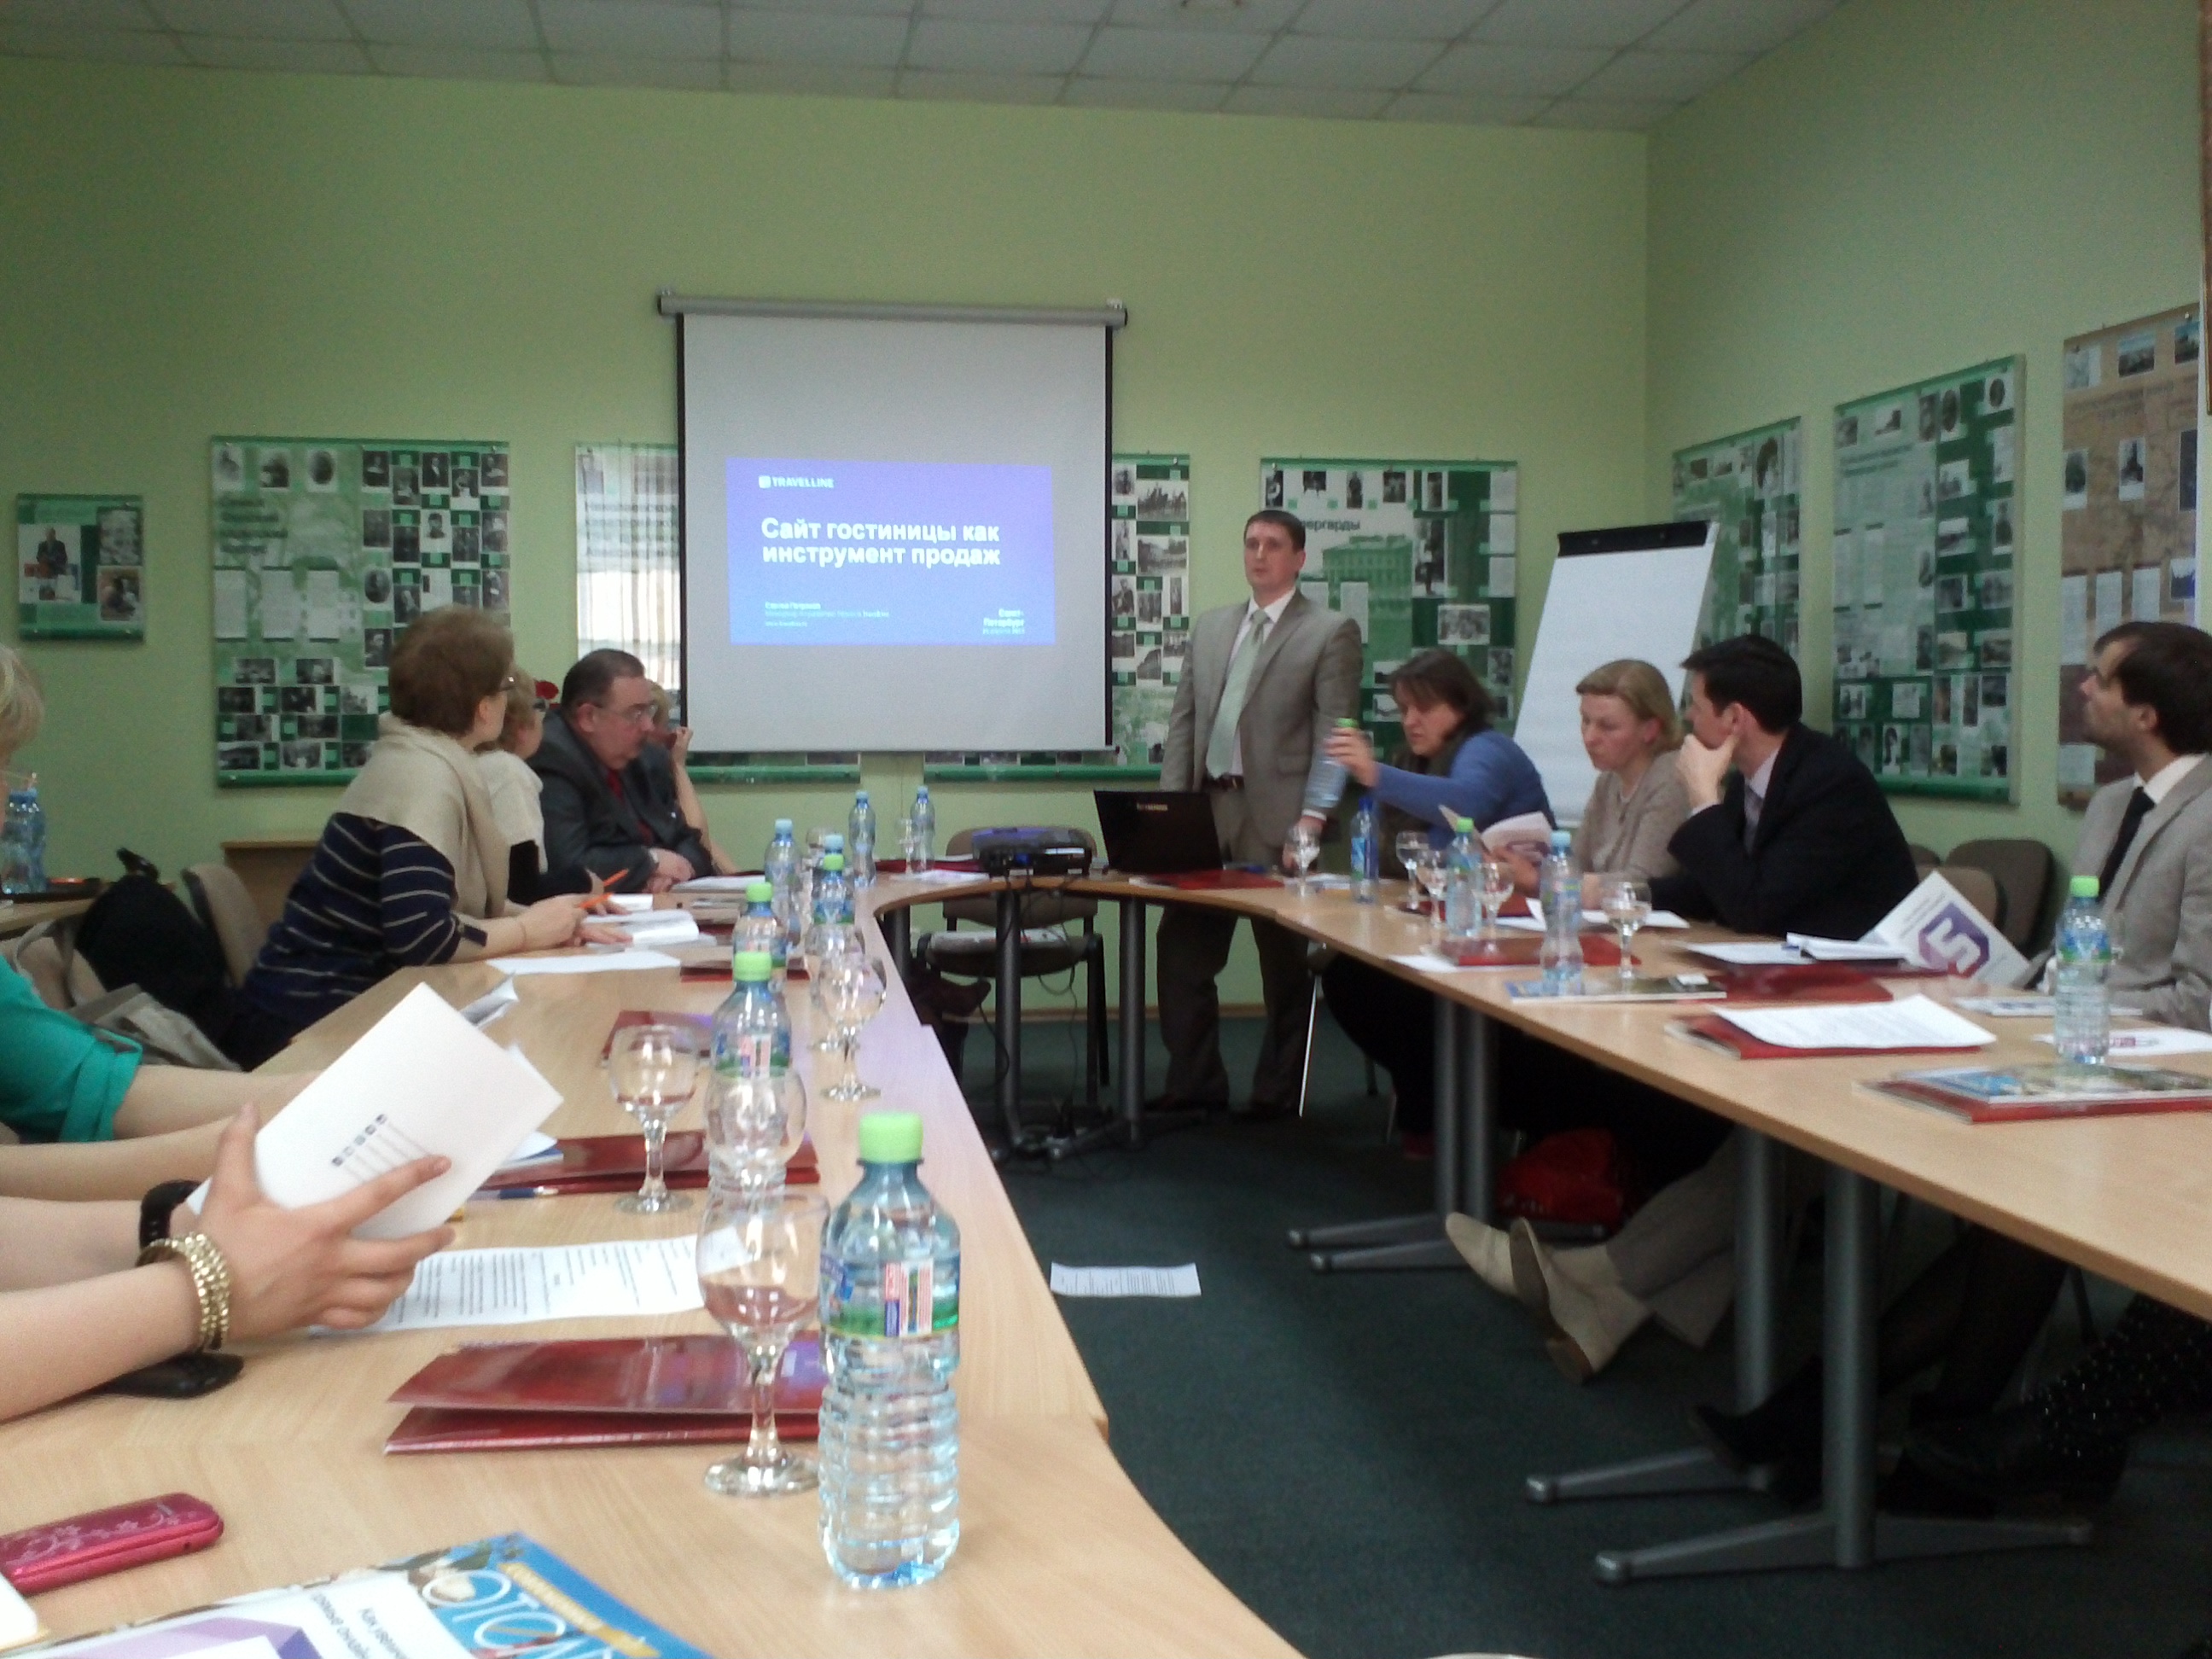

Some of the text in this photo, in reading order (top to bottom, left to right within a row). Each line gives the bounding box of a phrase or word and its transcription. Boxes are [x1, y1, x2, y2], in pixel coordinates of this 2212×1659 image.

[771, 476, 835, 488] TRAVELLINE
[761, 517, 999, 544] Сайт гостиницы как
[762, 546, 1001, 569] инструмент продаж
